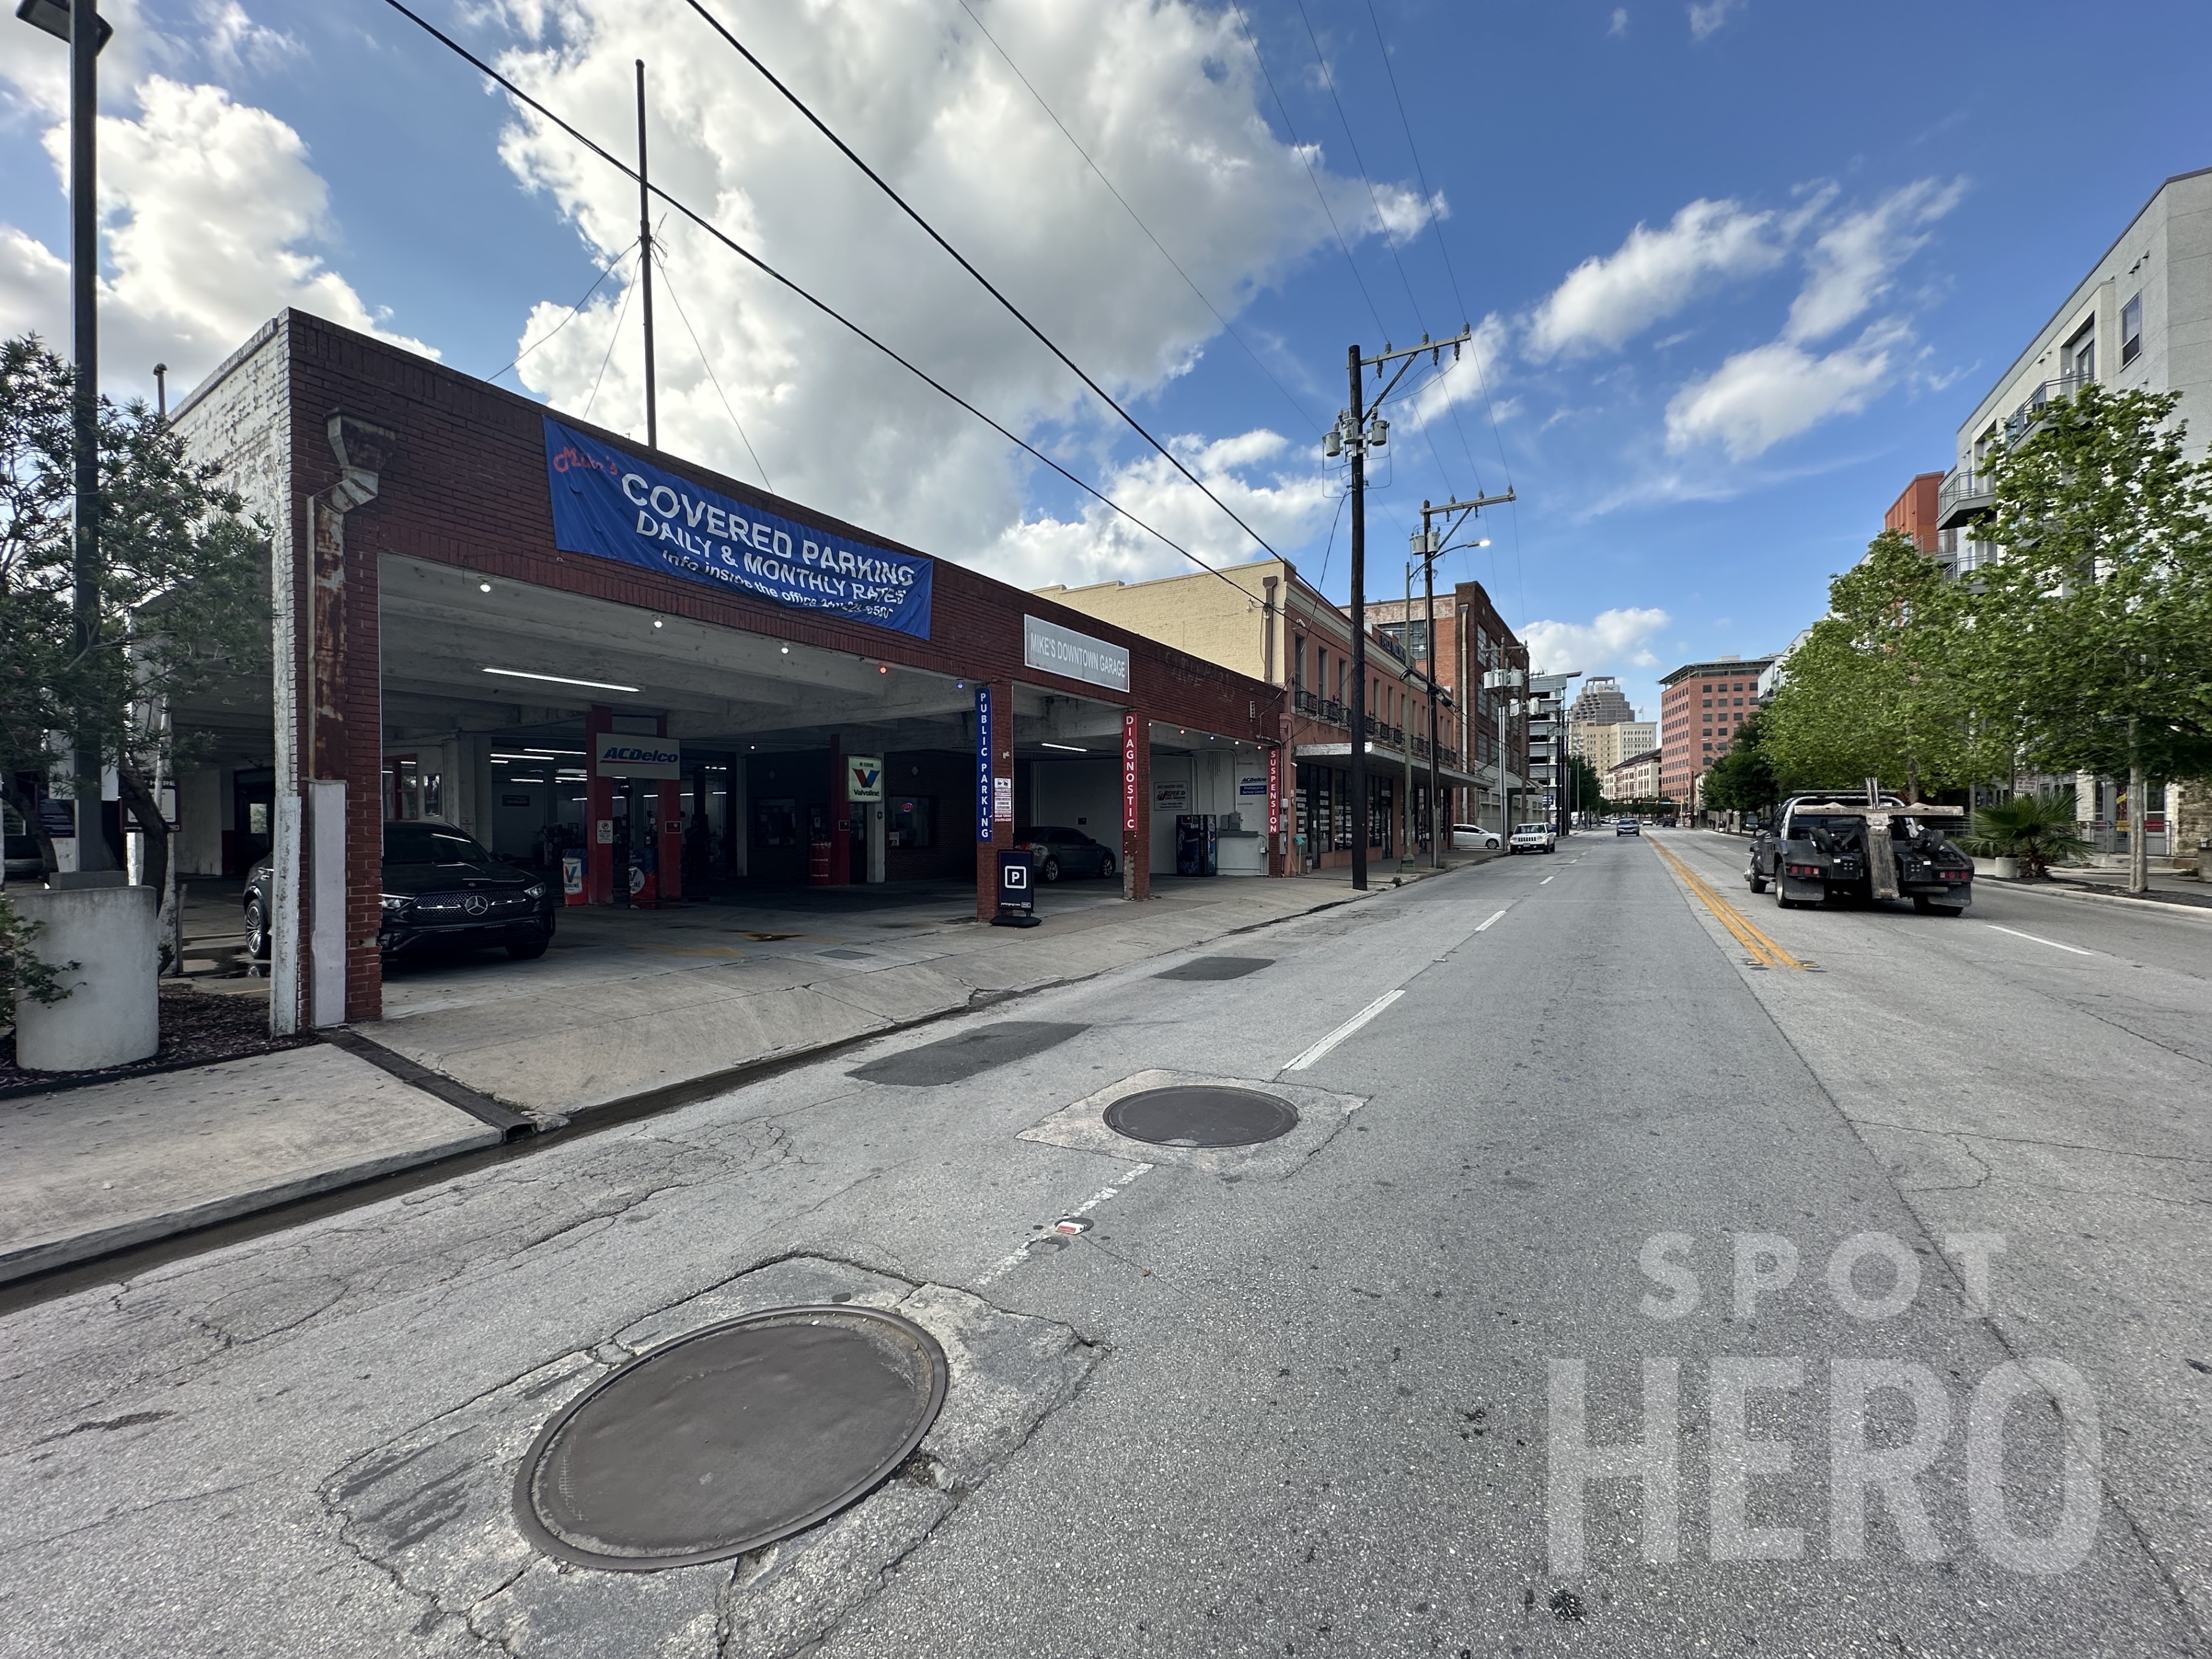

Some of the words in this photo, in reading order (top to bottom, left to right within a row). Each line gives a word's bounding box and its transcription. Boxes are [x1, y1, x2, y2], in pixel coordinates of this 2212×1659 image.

[622, 473, 792, 558] COVERED
[802, 540, 915, 586] PARKING
[636, 510, 711, 558] DAILY
[721, 545, 738, 568] &
[744, 552, 846, 597] MONTHLY
[851, 583, 907, 604] RATES
[662, 550, 699, 571] Info
[754, 581, 778, 597] the
[781, 590, 817, 607] office
[1031, 632, 1056, 658] MIKE'S
[1058, 641, 1099, 671] DOWNTOWN
[1100, 654, 1125, 678] GARAGE
[603, 747, 679, 763] ACDelco
[1126, 715, 1135, 828] DIAGNOSTIC
[854, 789, 880, 797] Valvoline
[1012, 872, 1020, 882] P
